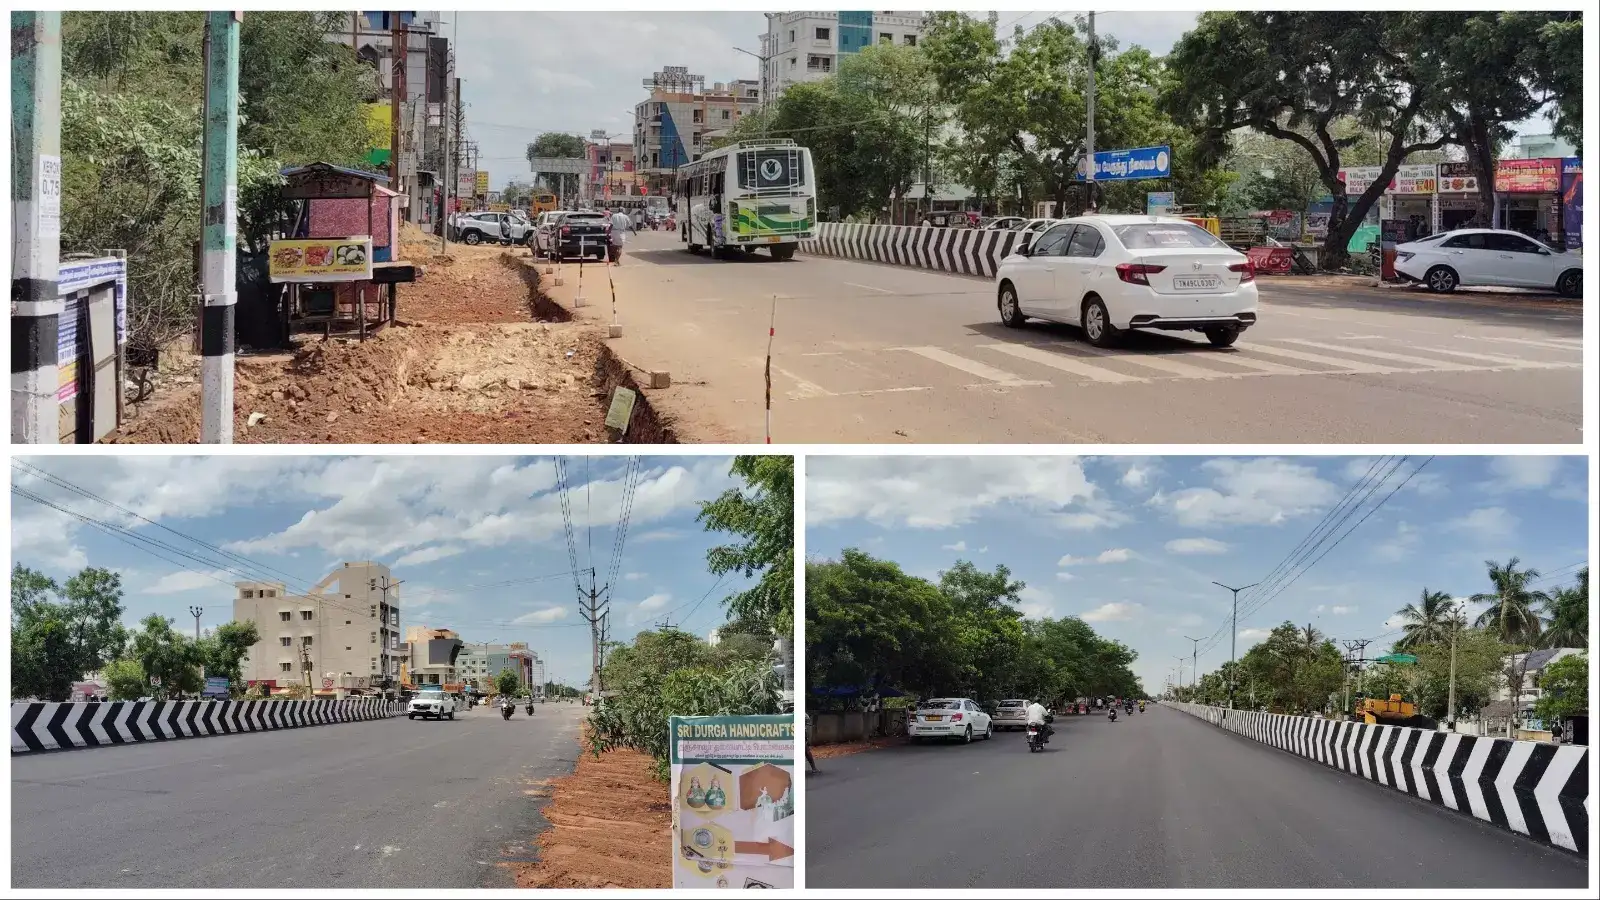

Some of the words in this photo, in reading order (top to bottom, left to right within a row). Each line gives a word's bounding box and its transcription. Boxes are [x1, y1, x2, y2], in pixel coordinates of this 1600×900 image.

[1400, 170, 1419, 178] Village
[1420, 169, 1435, 177] Milk
[42, 179, 60, 196] 0.75
[1424, 178, 1435, 191] 40
[677, 723, 692, 738] SRI
[694, 723, 727, 738] DURGA
[729, 722, 794, 738] HANDICRAFTS
